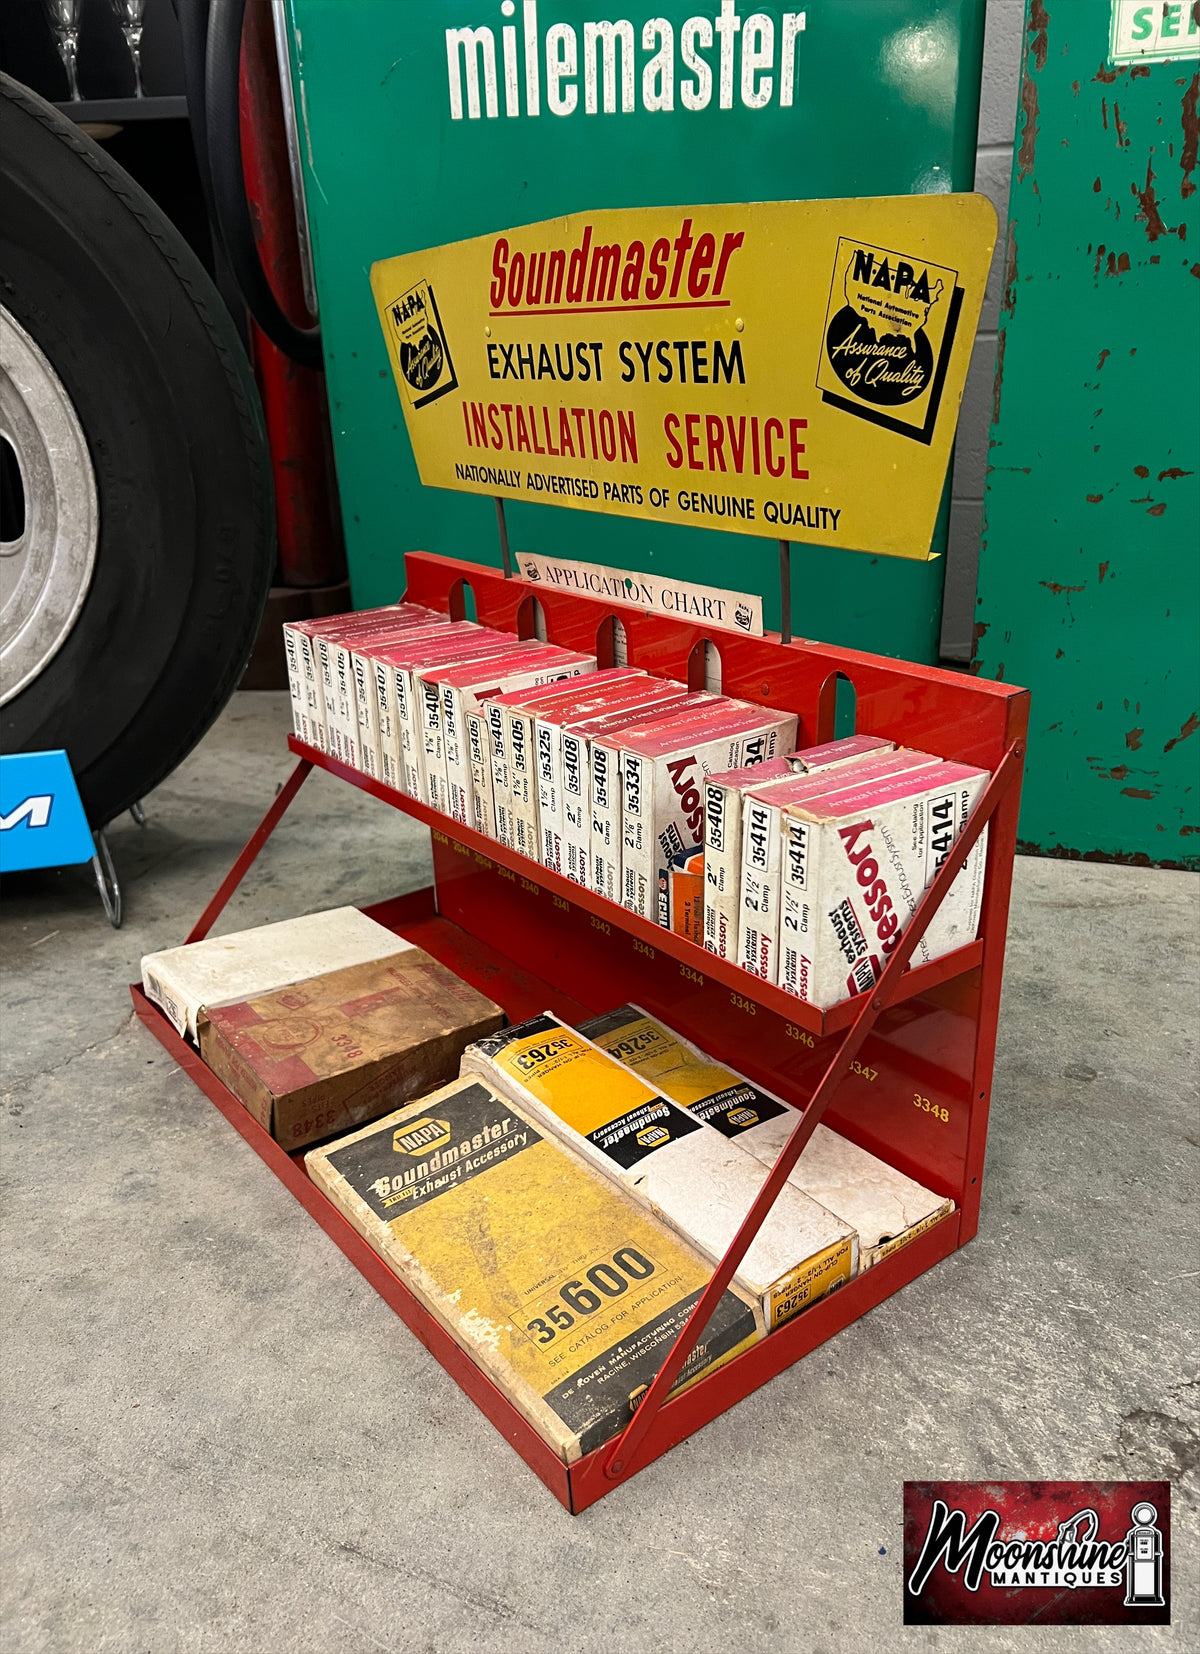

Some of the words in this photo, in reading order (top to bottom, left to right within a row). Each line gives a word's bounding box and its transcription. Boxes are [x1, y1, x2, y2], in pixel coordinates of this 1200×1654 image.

[445, 0, 806, 120] milemaster
[490, 218, 745, 309] Soundmaster
[857, 292, 883, 307] National
[884, 302, 919, 320] Automotive
[860, 304, 876, 316] Parts
[878, 310, 912, 327] Association
[832, 323, 907, 359] Assurance
[486, 341, 603, 382] EXHAUST
[618, 340, 746, 384] SYSTEM
[845, 357, 867, 387] of
[865, 358, 925, 397] Quality
[462, 401, 638, 464] INSTALLATION
[663, 413, 810, 480] SERVICE
[455, 463, 521, 488] NATIONALLY
[526, 472, 599, 499] ADVERTISED
[603, 481, 644, 505] PARTS
[649, 487, 670, 508] OF
[677, 490, 755, 520] GENUINE
[763, 501, 841, 531] QUALITY
[545, 565, 653, 604] APPLICATION
[661, 589, 726, 621] CHART
[285, 630, 298, 671] 35407
[336, 652, 347, 695] 35405
[354, 658, 366, 703] 35407
[376, 665, 388, 710] 35407
[443, 688, 455, 737] 35405
[489, 708, 504, 757] 35405
[452, 742, 460, 766] Clamp
[469, 720, 481, 761] 35405
[511, 720, 525, 770] 35405
[538, 729, 552, 780] 35325
[767, 731, 777, 760] lamp
[501, 763, 509, 788] Clamp
[564, 739, 579, 793] 35408
[593, 748, 607, 806] 35408
[625, 758, 640, 813] 35334
[549, 788, 557, 812] Clamp
[666, 755, 704, 844] ssory
[707, 788, 723, 848] 35408
[911, 803, 919, 836] Catalog
[526, 822, 535, 861] cessory
[603, 820, 611, 845] Clamp
[635, 822, 643, 850] Clamp
[750, 810, 768, 867] 35414
[917, 801, 925, 843] Application
[553, 833, 562, 876] cessory
[578, 847, 587, 888] cessory
[789, 826, 806, 885] 35414
[605, 861, 616, 902] cessory
[638, 873, 648, 917] cessory
[718, 866, 726, 892] Clamp
[760, 884, 770, 913] Clamp
[837, 819, 906, 960] cessory
[708, 907, 716, 938] systems
[717, 912, 729, 959] cessory
[800, 903, 810, 933] Clamp
[828, 908, 857, 965] exhaust
[838, 899, 867, 957] systems
[749, 929, 757, 962] systems
[759, 933, 772, 979] cessory
[789, 950, 797, 984] systems
[798, 954, 811, 1002] cessory
[497, 864, 516, 884] 2044
[520, 877, 539, 896] 3340
[552, 895, 570, 912] 3341
[590, 915, 611, 936] 3342
[632, 938, 655, 960] 3343
[679, 964, 704, 987] 3344
[729, 992, 757, 1016] 3345
[785, 1023, 815, 1049] 3346
[912, 1093, 950, 1123] 3348
[516, 1037, 574, 1070] 35263
[607, 1029, 660, 1060] 35264
[625, 1105, 651, 1127] Exhaust
[688, 1096, 717, 1114] Accesso
[699, 1090, 757, 1121] Soundmaste
[730, 1110, 756, 1124] NAPA
[398, 1121, 446, 1151] NAPA
[592, 1118, 625, 1141] Accessory
[598, 1105, 671, 1149] Soundmaster
[639, 1127, 667, 1144] NAPA
[375, 1117, 512, 1198] Soundmaster
[411, 1165, 462, 1200] Exhaust
[464, 1131, 528, 1174] Accessory
[813, 1259, 838, 1279] CLIP-ON
[823, 1253, 835, 1266] ALL
[836, 1246, 849, 1259] FOR
[524, 1273, 557, 1296] UNIVERSAL
[526, 1247, 656, 1344] 35600
[776, 1287, 809, 1318] 35263
[784, 1277, 812, 1298] HANGER
[548, 1353, 568, 1368] SEE
[568, 1324, 609, 1354] CATALOG
[610, 1309, 629, 1325] FOR
[630, 1275, 683, 1312] APPLICATION
[561, 1389, 575, 1400] DE
[608, 1317, 676, 1364] MANUFACTURING
[677, 1298, 702, 1318] COMP
[597, 1359, 631, 1385] RACINE,
[629, 1328, 676, 1361] WISCONSIN
[674, 1314, 694, 1331] 534
